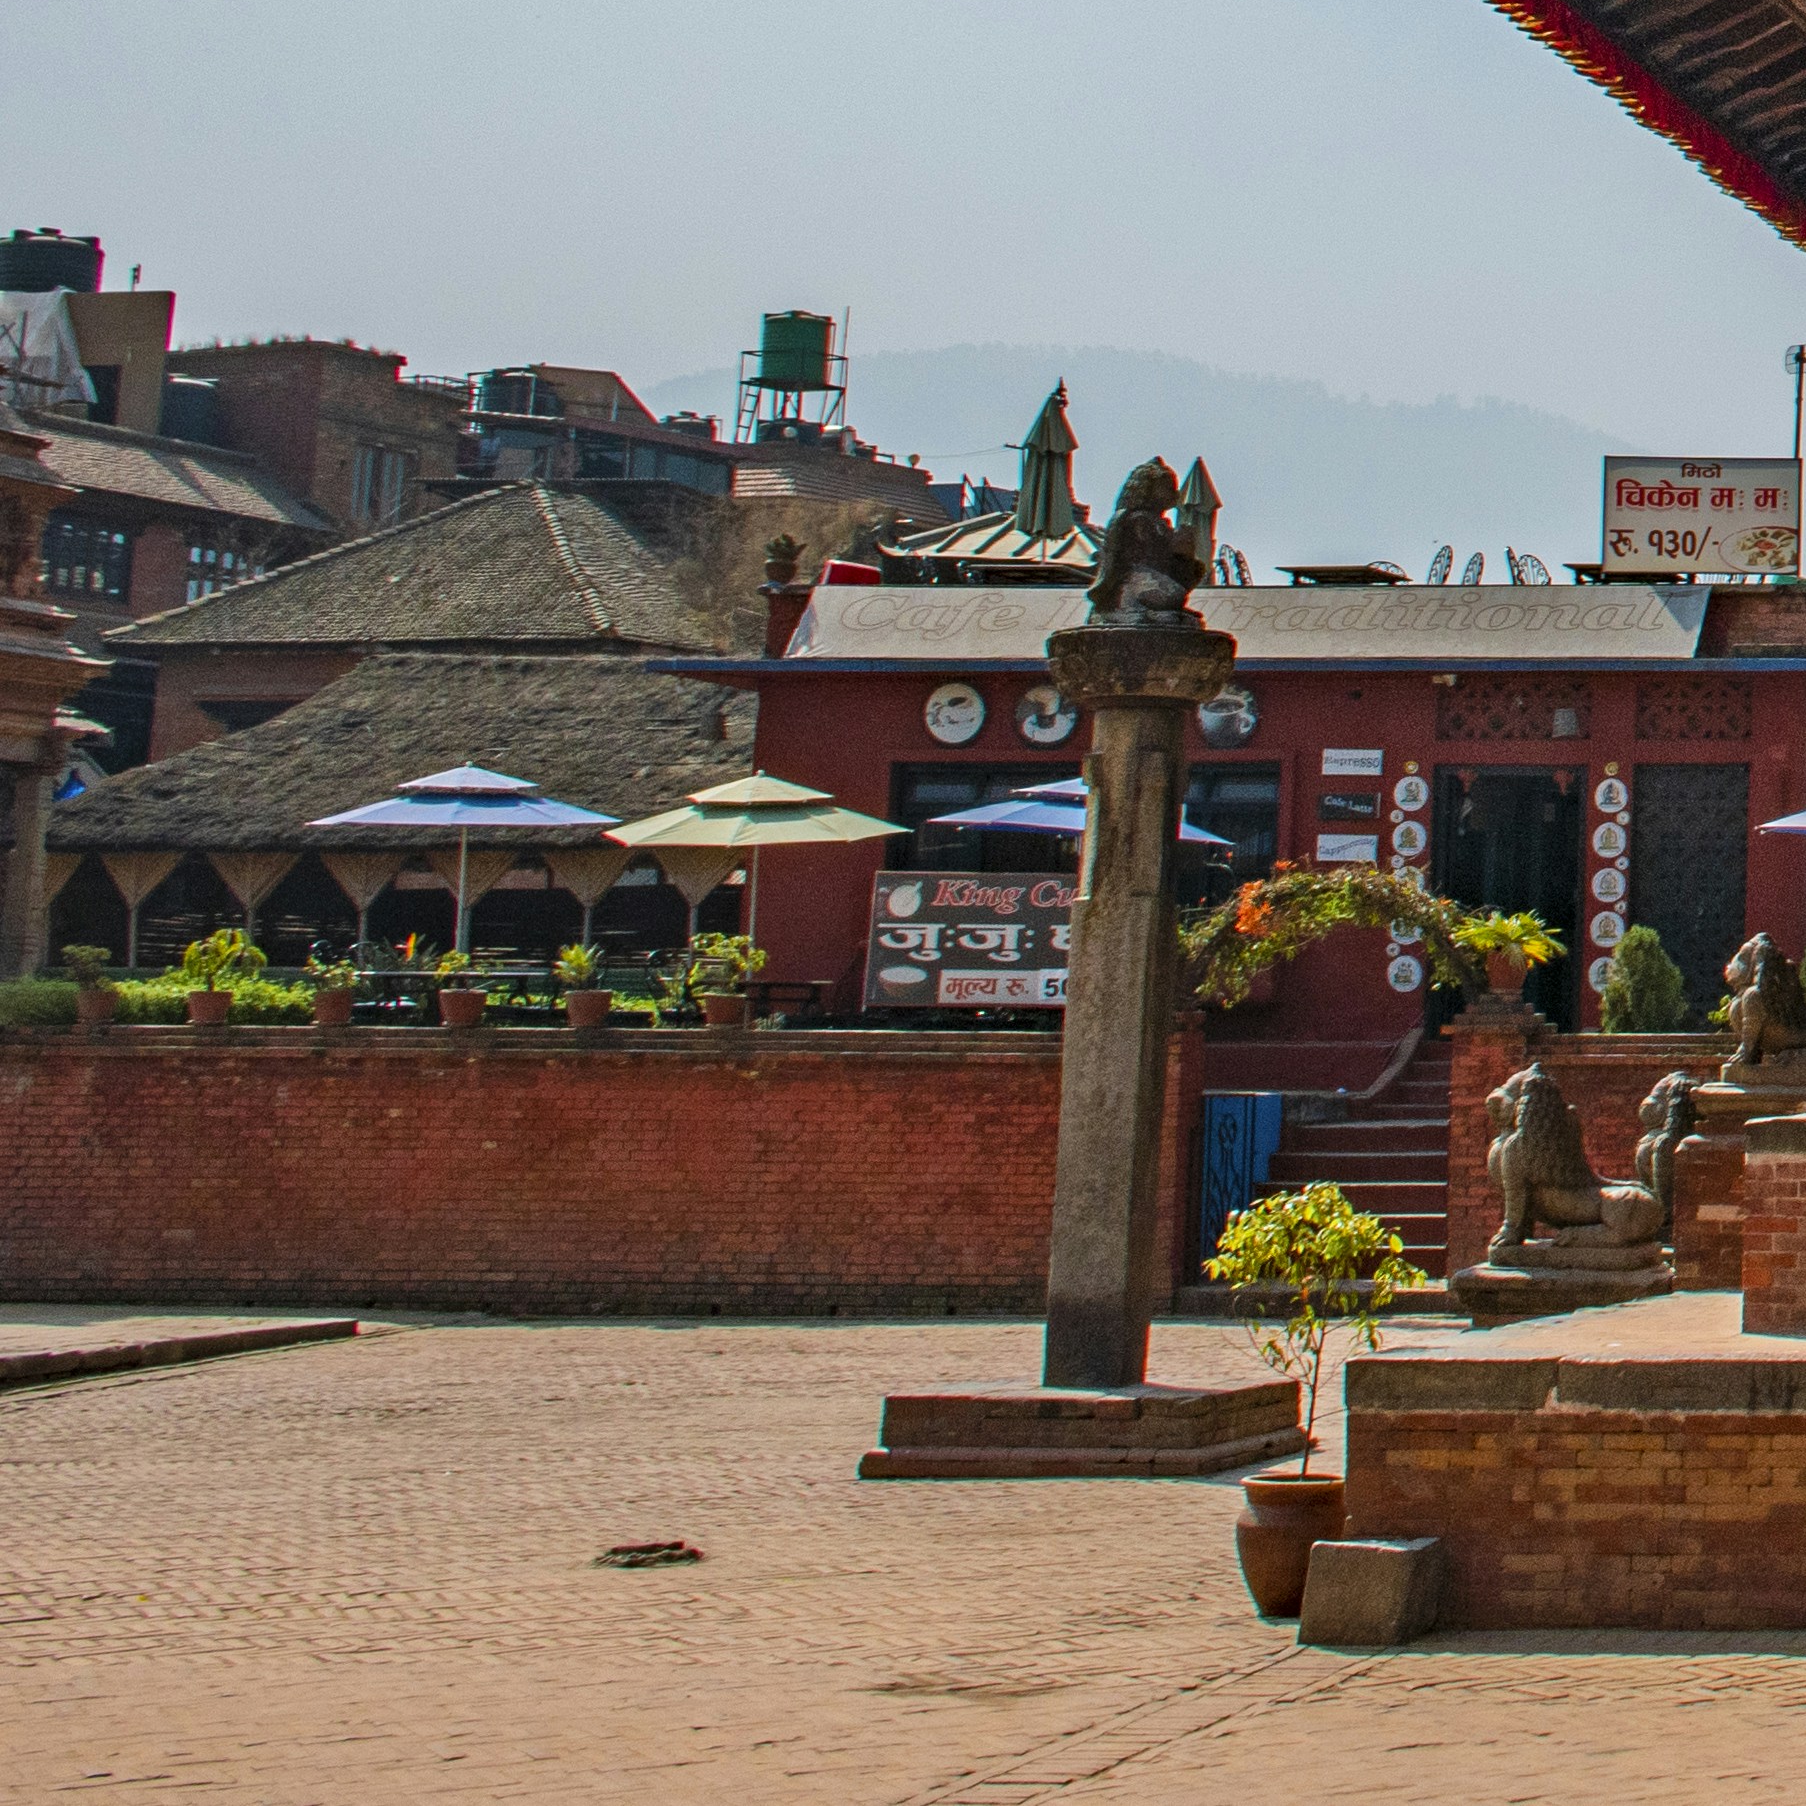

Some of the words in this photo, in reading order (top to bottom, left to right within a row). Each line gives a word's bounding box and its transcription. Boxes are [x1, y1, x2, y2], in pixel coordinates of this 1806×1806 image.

[1681, 463, 1723, 479] मिठो
[1615, 478, 1702, 509] चिकेन
[841, 592, 1026, 641] Cafe
[1192, 591, 1664, 632] Traditional
[931, 879, 1026, 914] King
[945, 977, 998, 1000] मूल्य
